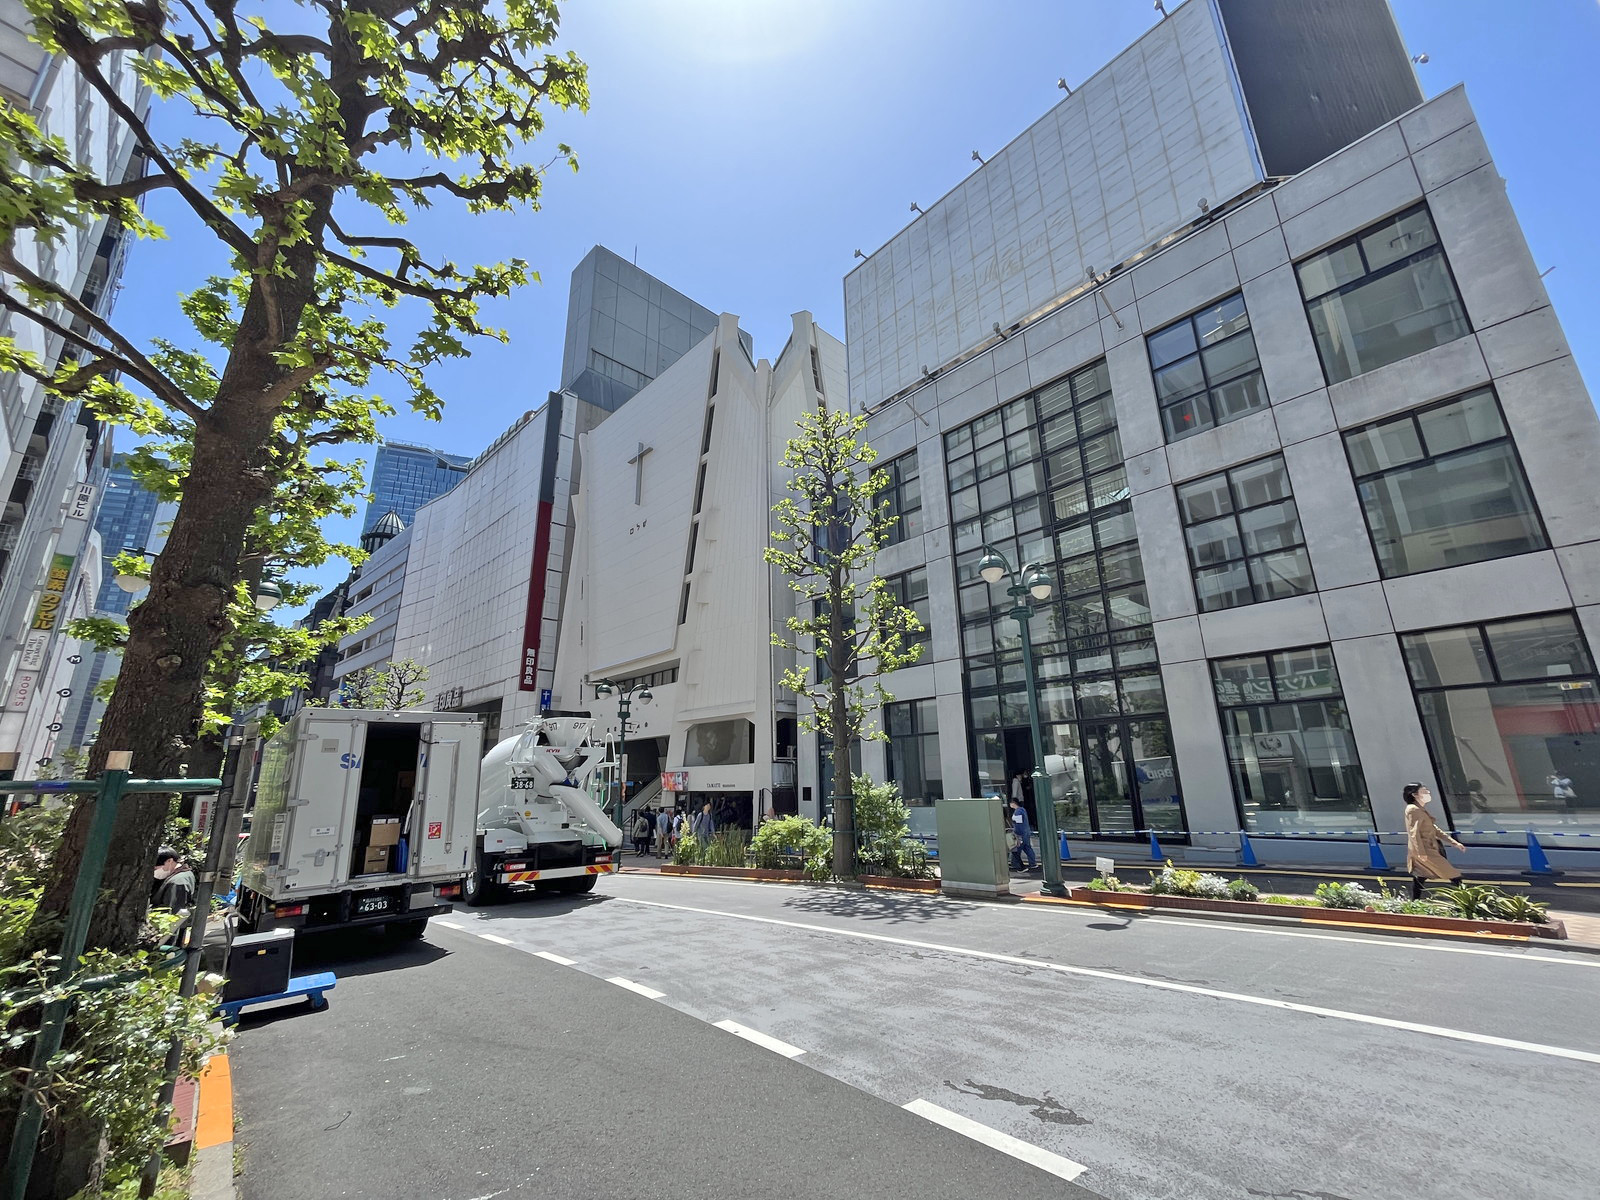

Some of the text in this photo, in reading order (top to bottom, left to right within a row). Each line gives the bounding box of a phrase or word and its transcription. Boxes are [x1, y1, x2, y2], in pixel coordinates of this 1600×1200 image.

[523, 648, 536, 685] 無印良品
[573, 722, 586, 730] 917
[364, 900, 388, 912] 63-03
